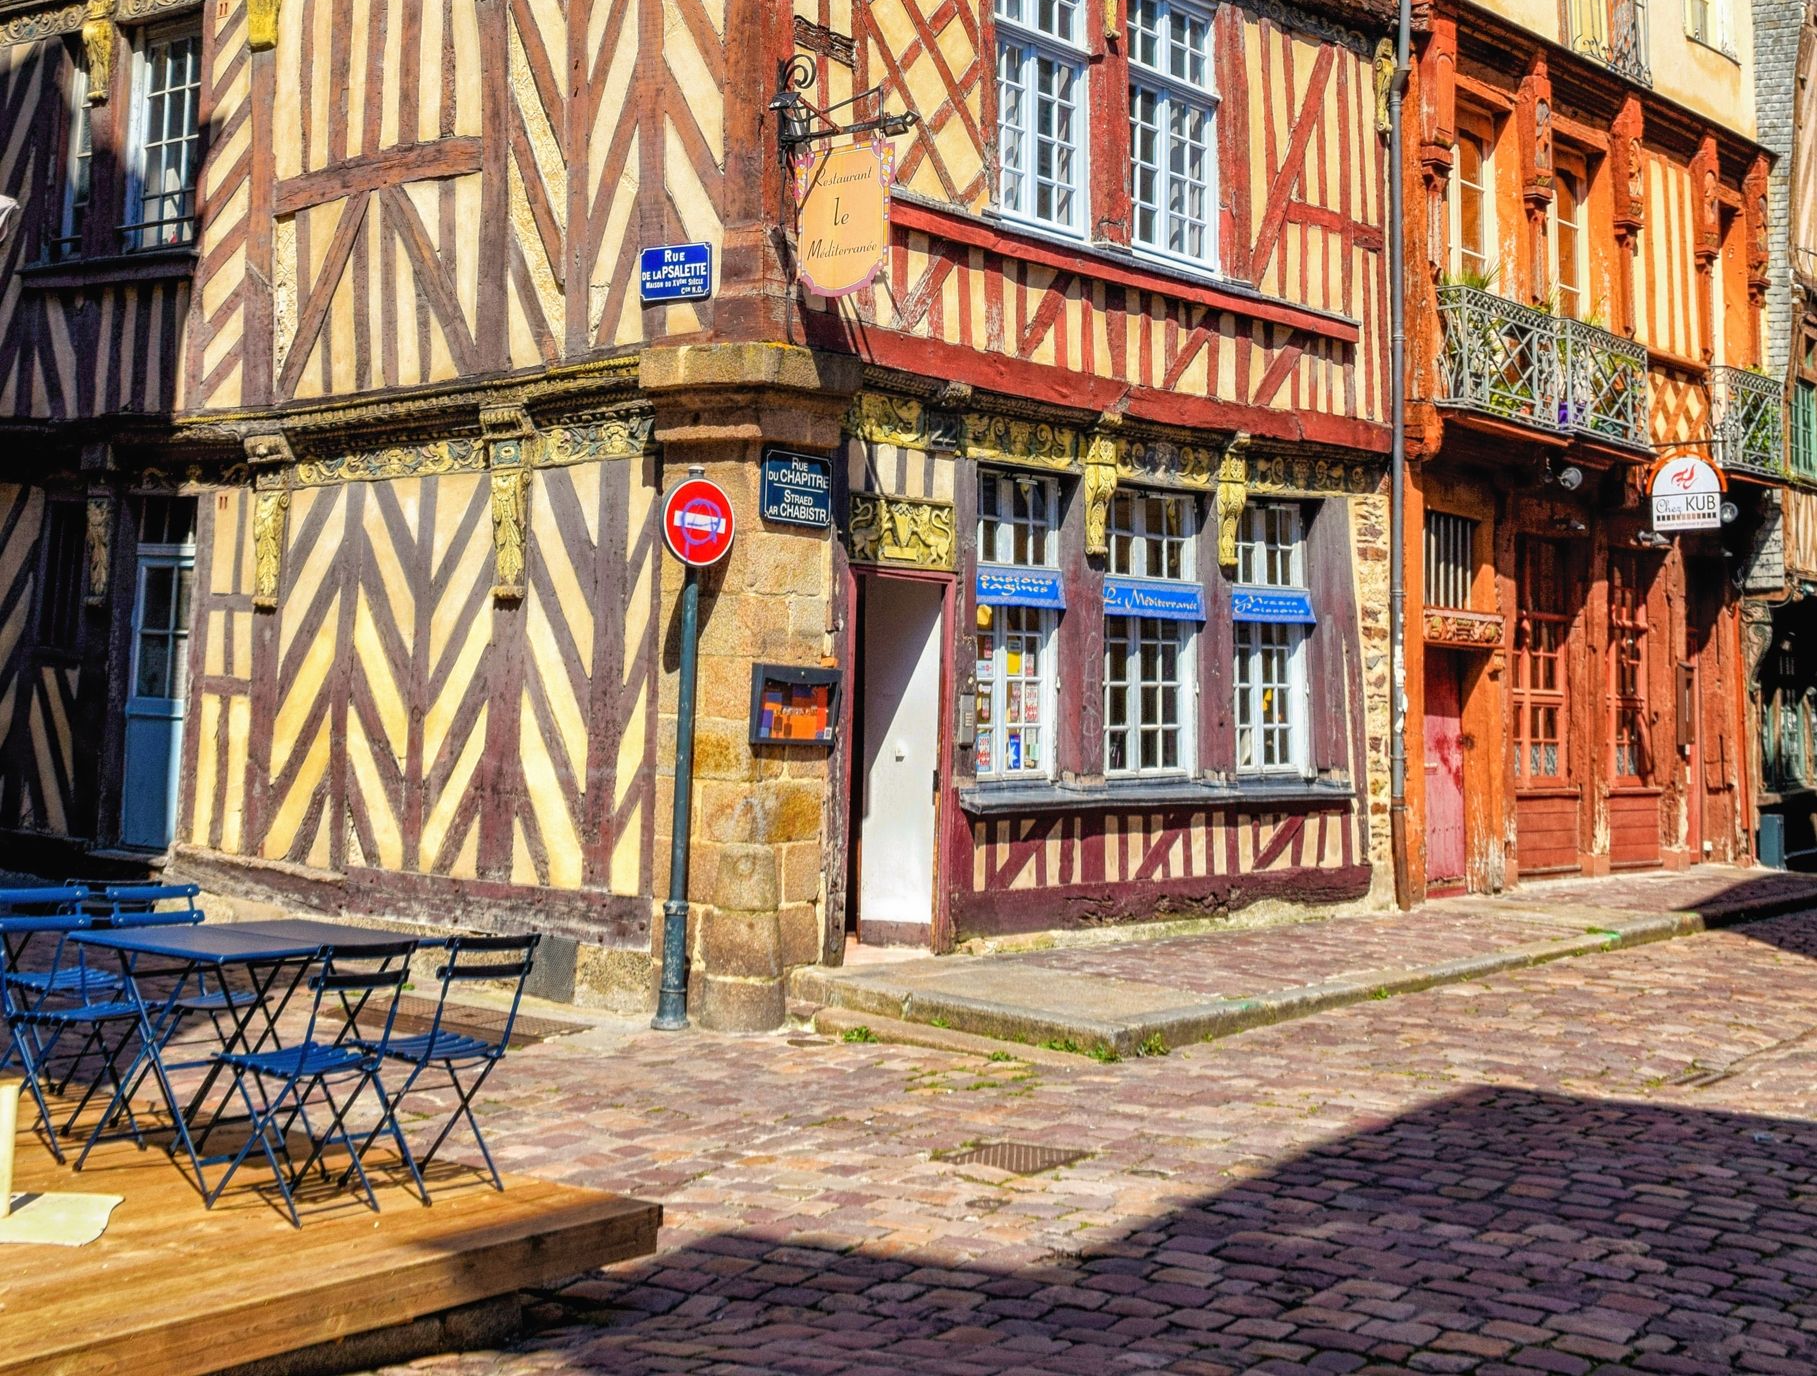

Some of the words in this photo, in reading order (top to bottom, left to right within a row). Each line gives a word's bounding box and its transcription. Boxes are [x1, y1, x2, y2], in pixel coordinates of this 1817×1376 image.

[813, 166, 872, 187] Restaurant
[833, 197, 850, 226] le
[807, 238, 877, 261] Méditerranée
[641, 271, 651, 281] DE
[662, 262, 707, 279] PSALETTE
[768, 471, 779, 481] DU
[780, 469, 829, 489] CHAPITRE
[768, 505, 778, 515] AR
[780, 503, 826, 522] CHABISTR
[1656, 498, 1682, 516] Chez
[1685, 495, 1716, 511] KUB
[979, 575, 1053, 585] ouscous
[1103, 587, 1121, 605] Le
[1125, 588, 1197, 609] Méditerranée
